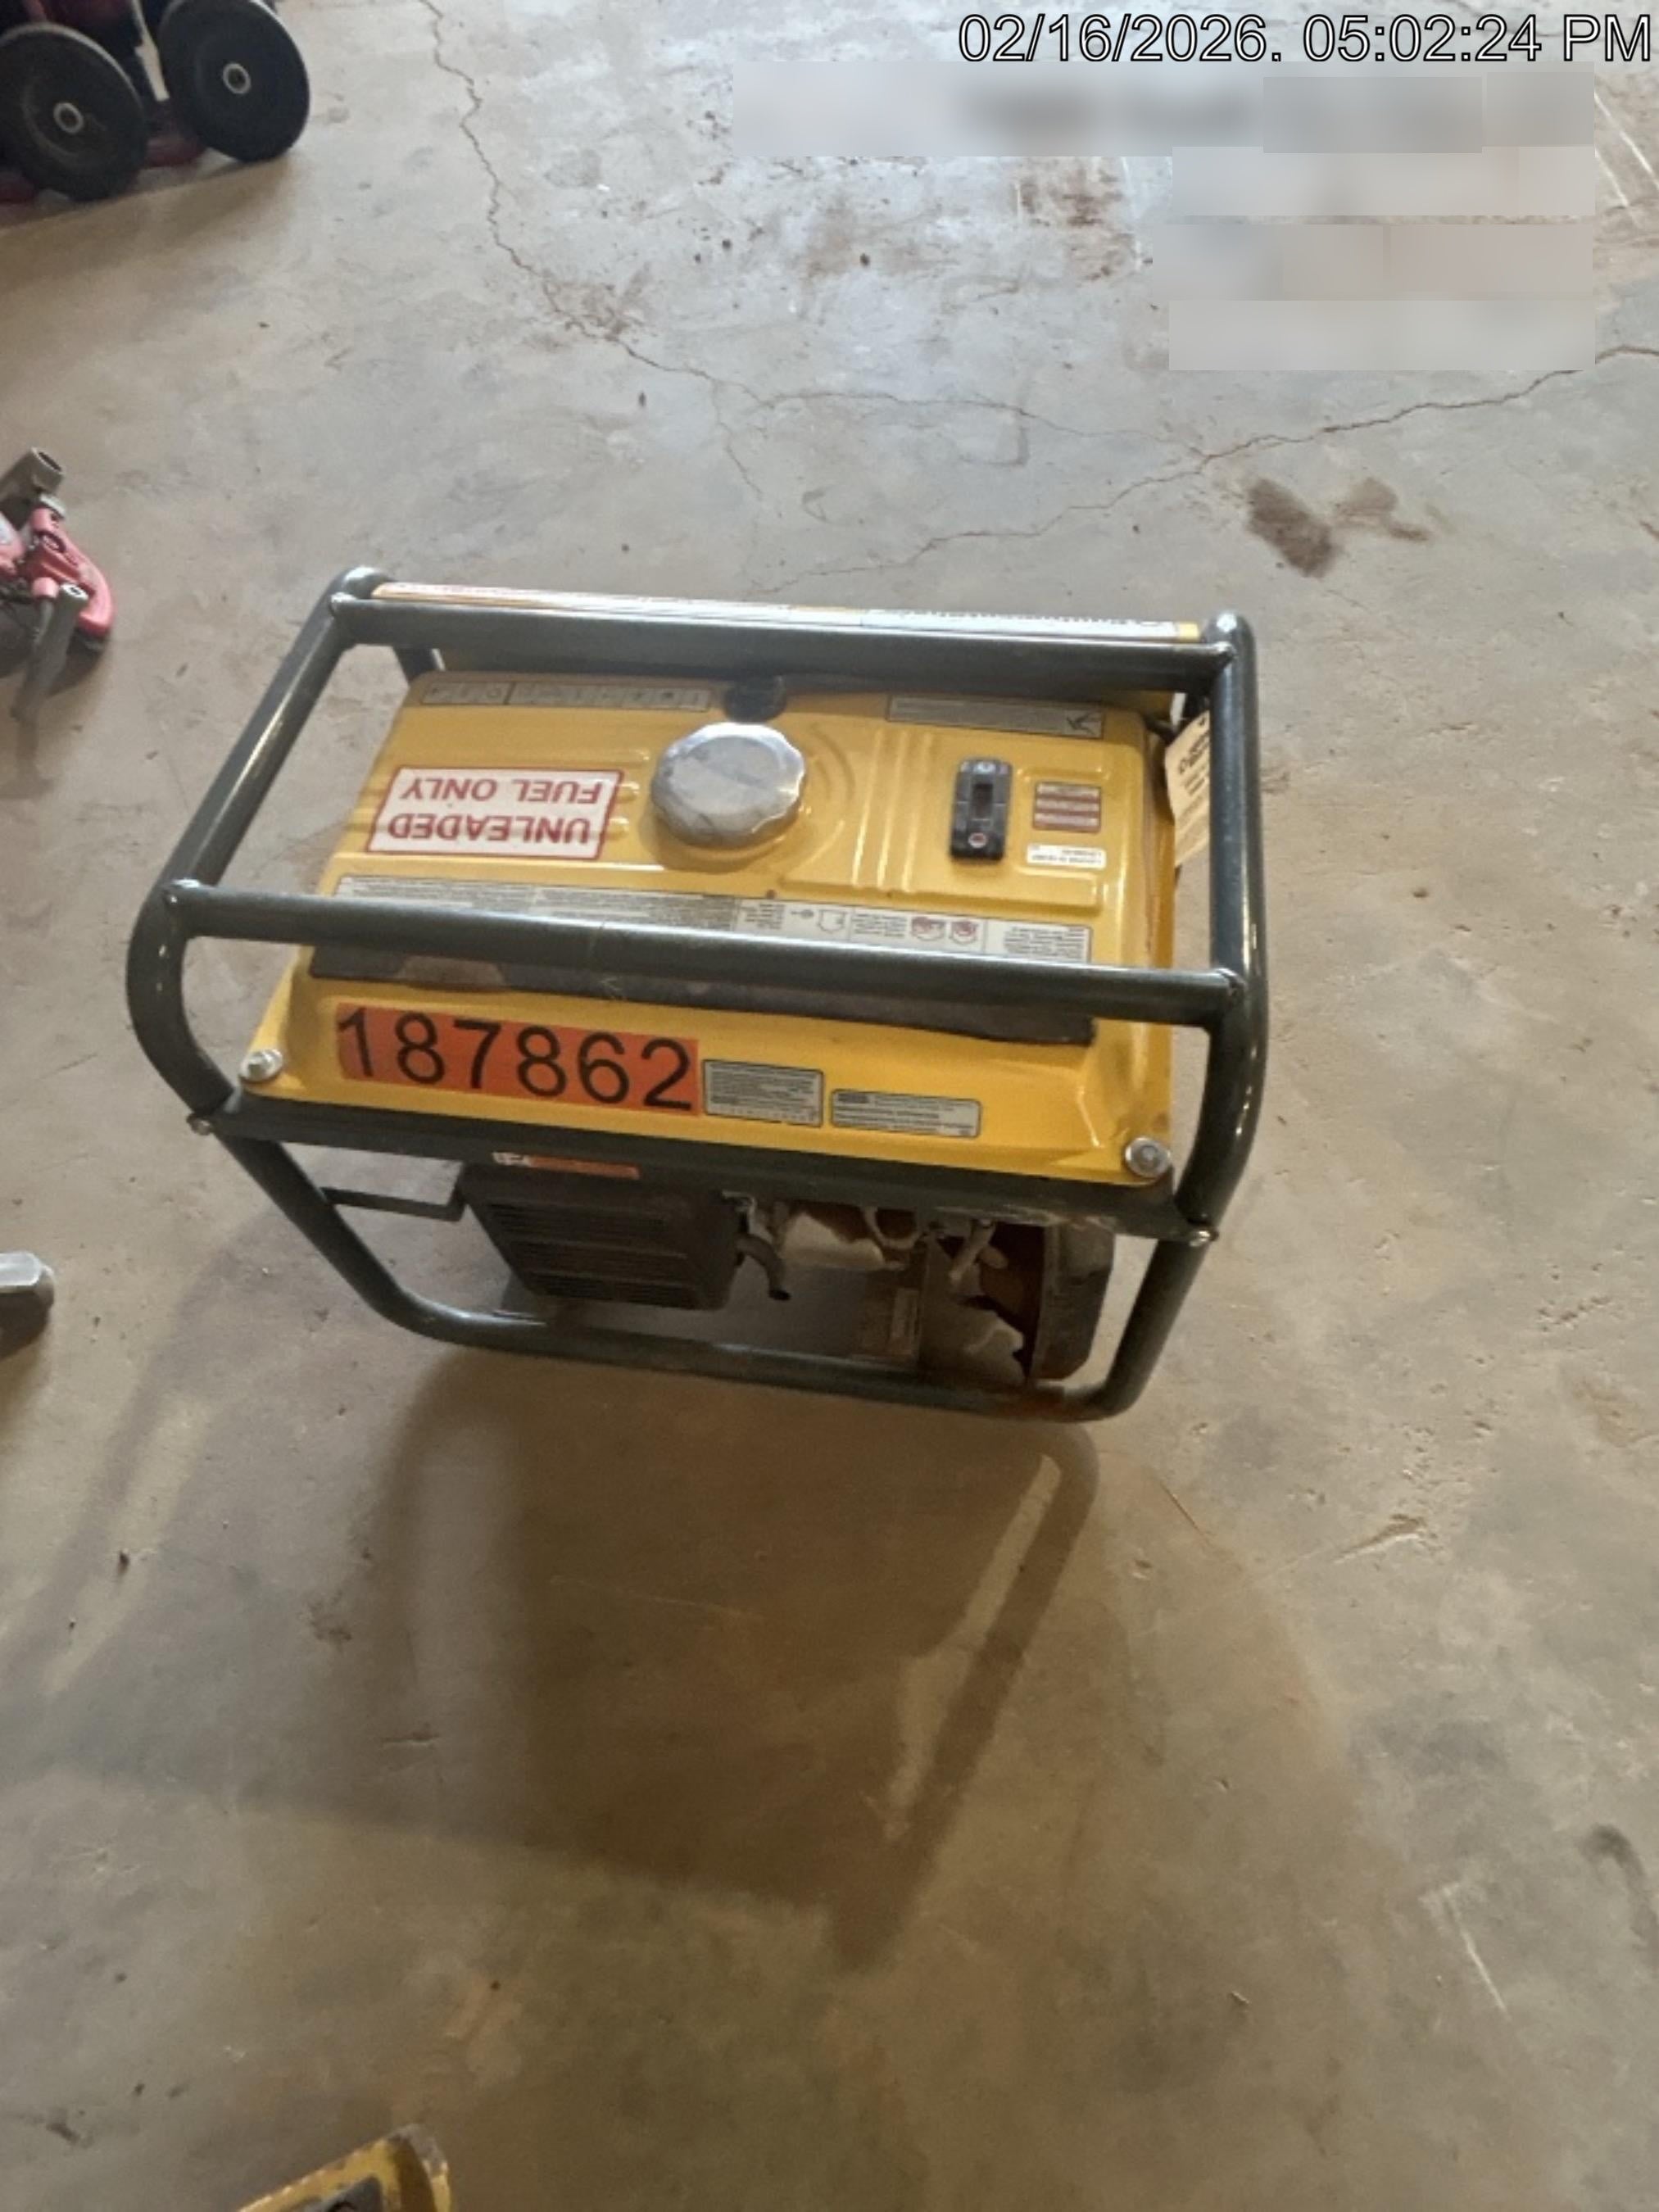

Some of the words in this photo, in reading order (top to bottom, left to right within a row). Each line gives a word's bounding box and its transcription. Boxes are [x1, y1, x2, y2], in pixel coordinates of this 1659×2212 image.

[400, 777, 498, 802] ONLY
[511, 778, 604, 805] FUEL
[388, 813, 592, 844] UNLEADED
[338, 1006, 693, 1112] 187862
